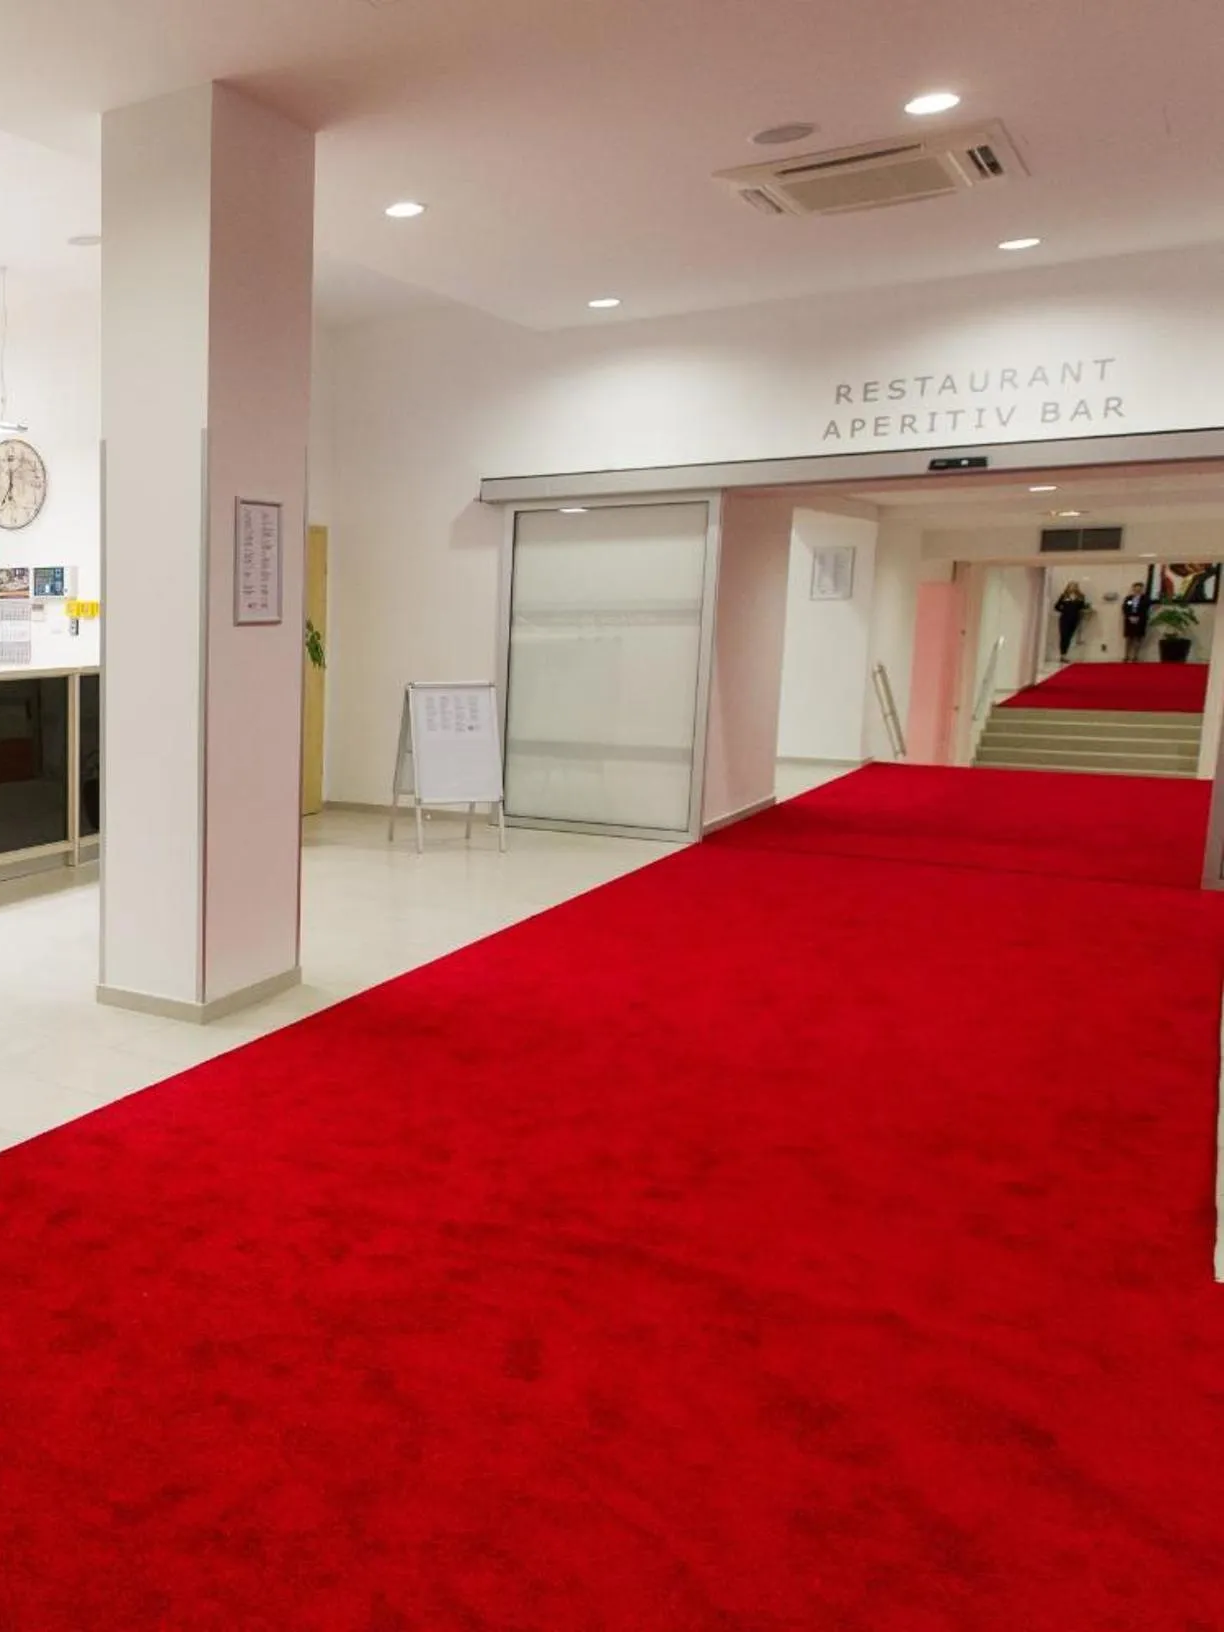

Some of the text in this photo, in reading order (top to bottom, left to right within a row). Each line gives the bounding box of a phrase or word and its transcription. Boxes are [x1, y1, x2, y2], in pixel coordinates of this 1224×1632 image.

[836, 359, 1115, 405] RESTAURANT
[823, 397, 1125, 440] APERITIV BAR
